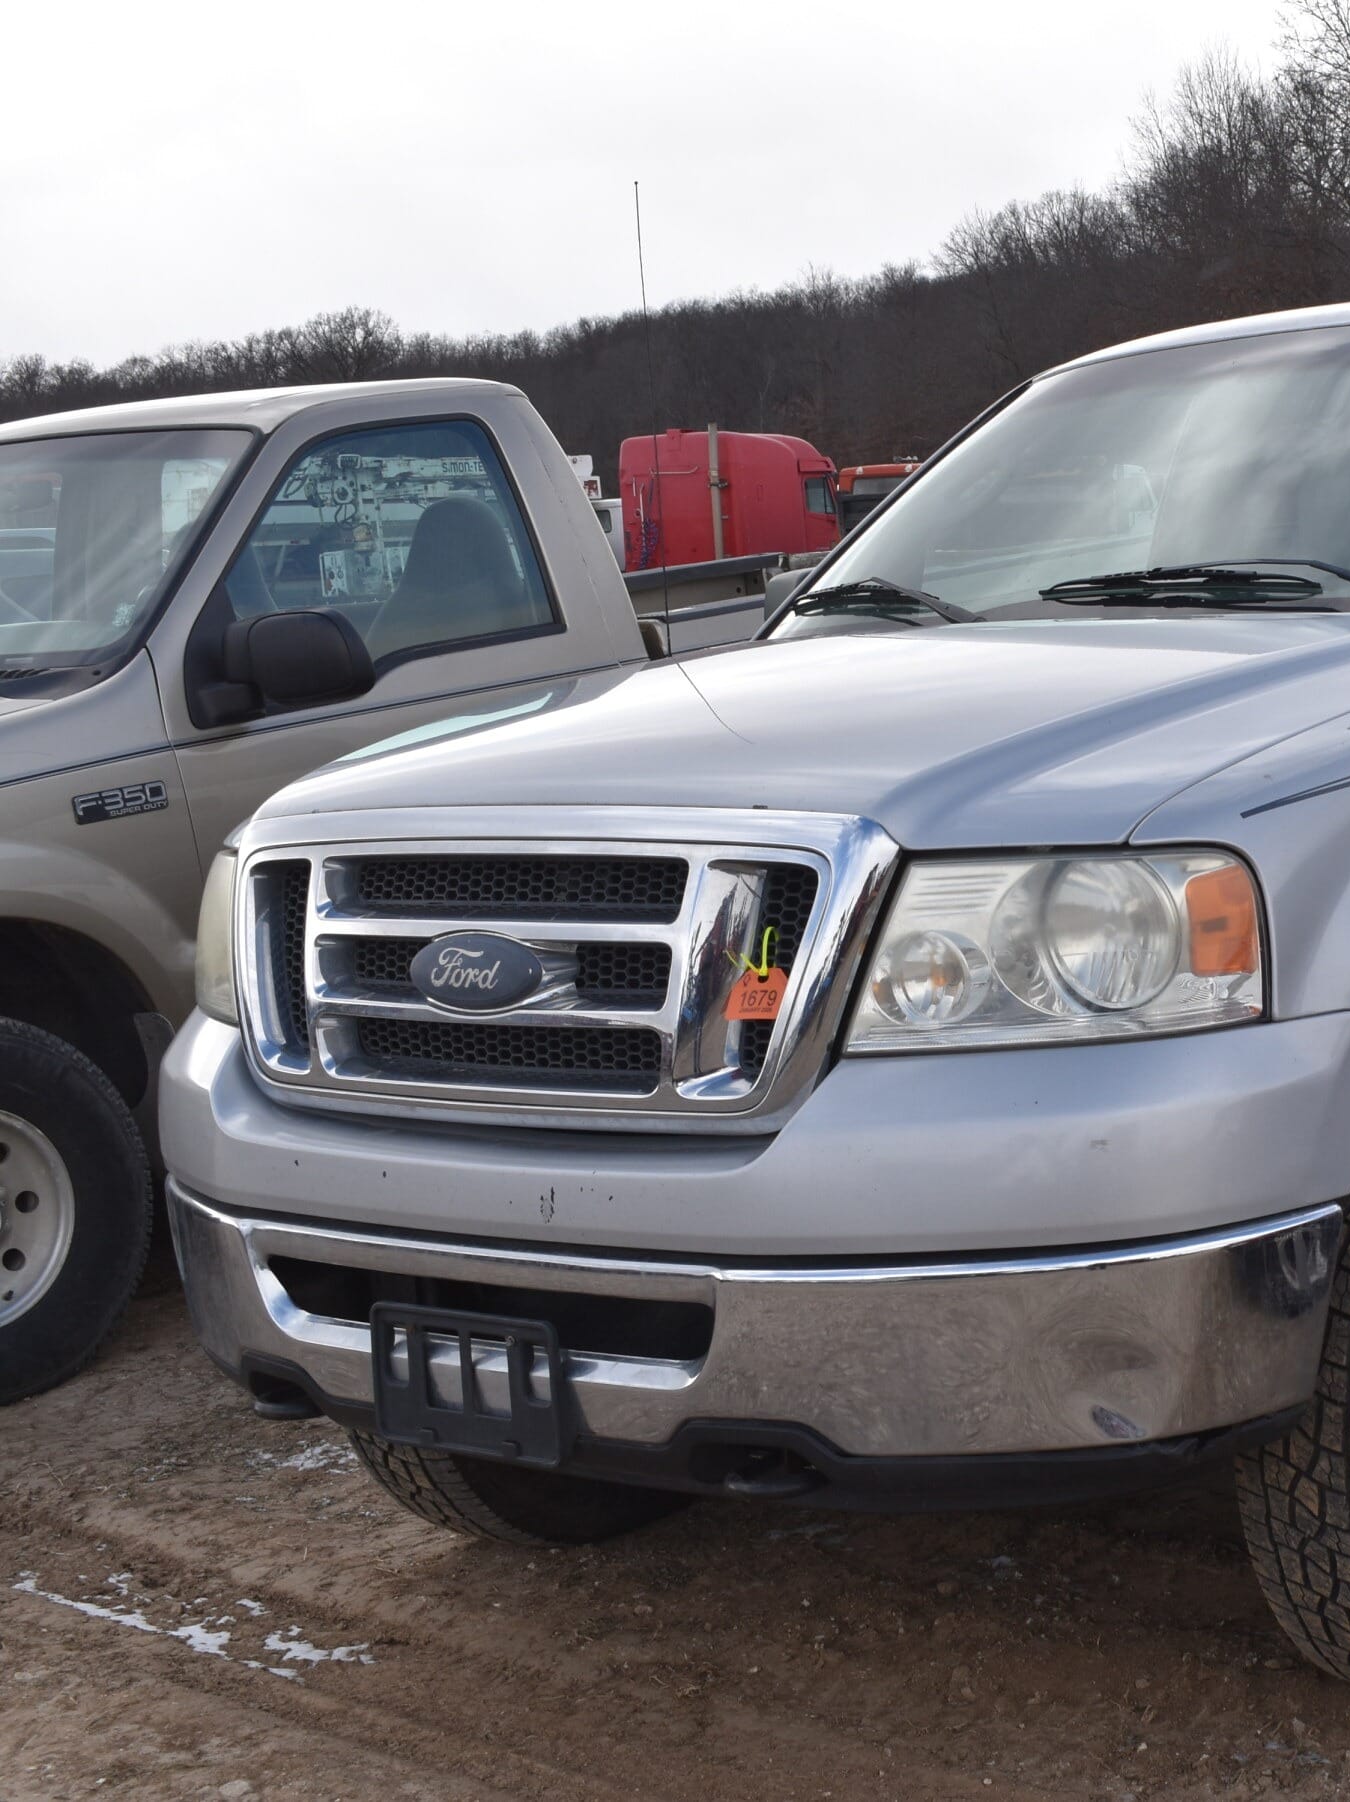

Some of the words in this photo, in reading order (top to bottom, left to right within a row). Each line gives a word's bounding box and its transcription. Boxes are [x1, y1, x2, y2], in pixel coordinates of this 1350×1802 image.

[110, 805, 141, 816] SUPER
[143, 799, 168, 810] DUTY
[431, 947, 501, 989] Ford
[740, 989, 778, 1007] 1679
